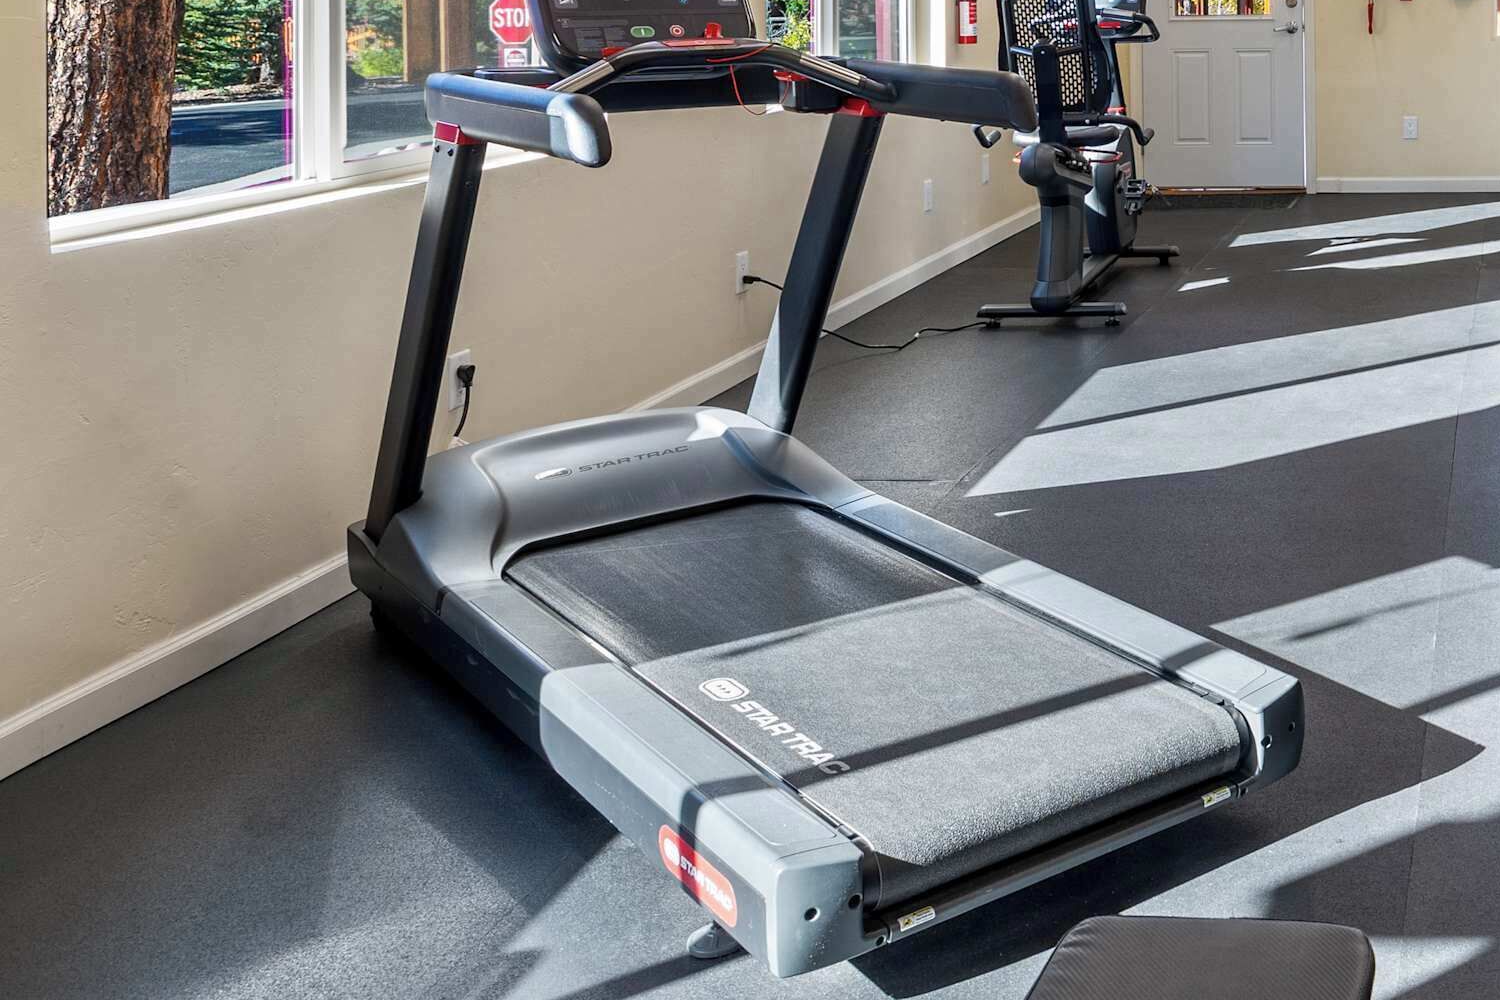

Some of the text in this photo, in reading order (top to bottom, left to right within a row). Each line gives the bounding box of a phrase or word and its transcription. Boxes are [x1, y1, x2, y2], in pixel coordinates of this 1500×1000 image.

[578, 444, 690, 473] STAR TRAC
[730, 700, 851, 775] STAR TRAC
[679, 856, 734, 911] STAR TRAC
